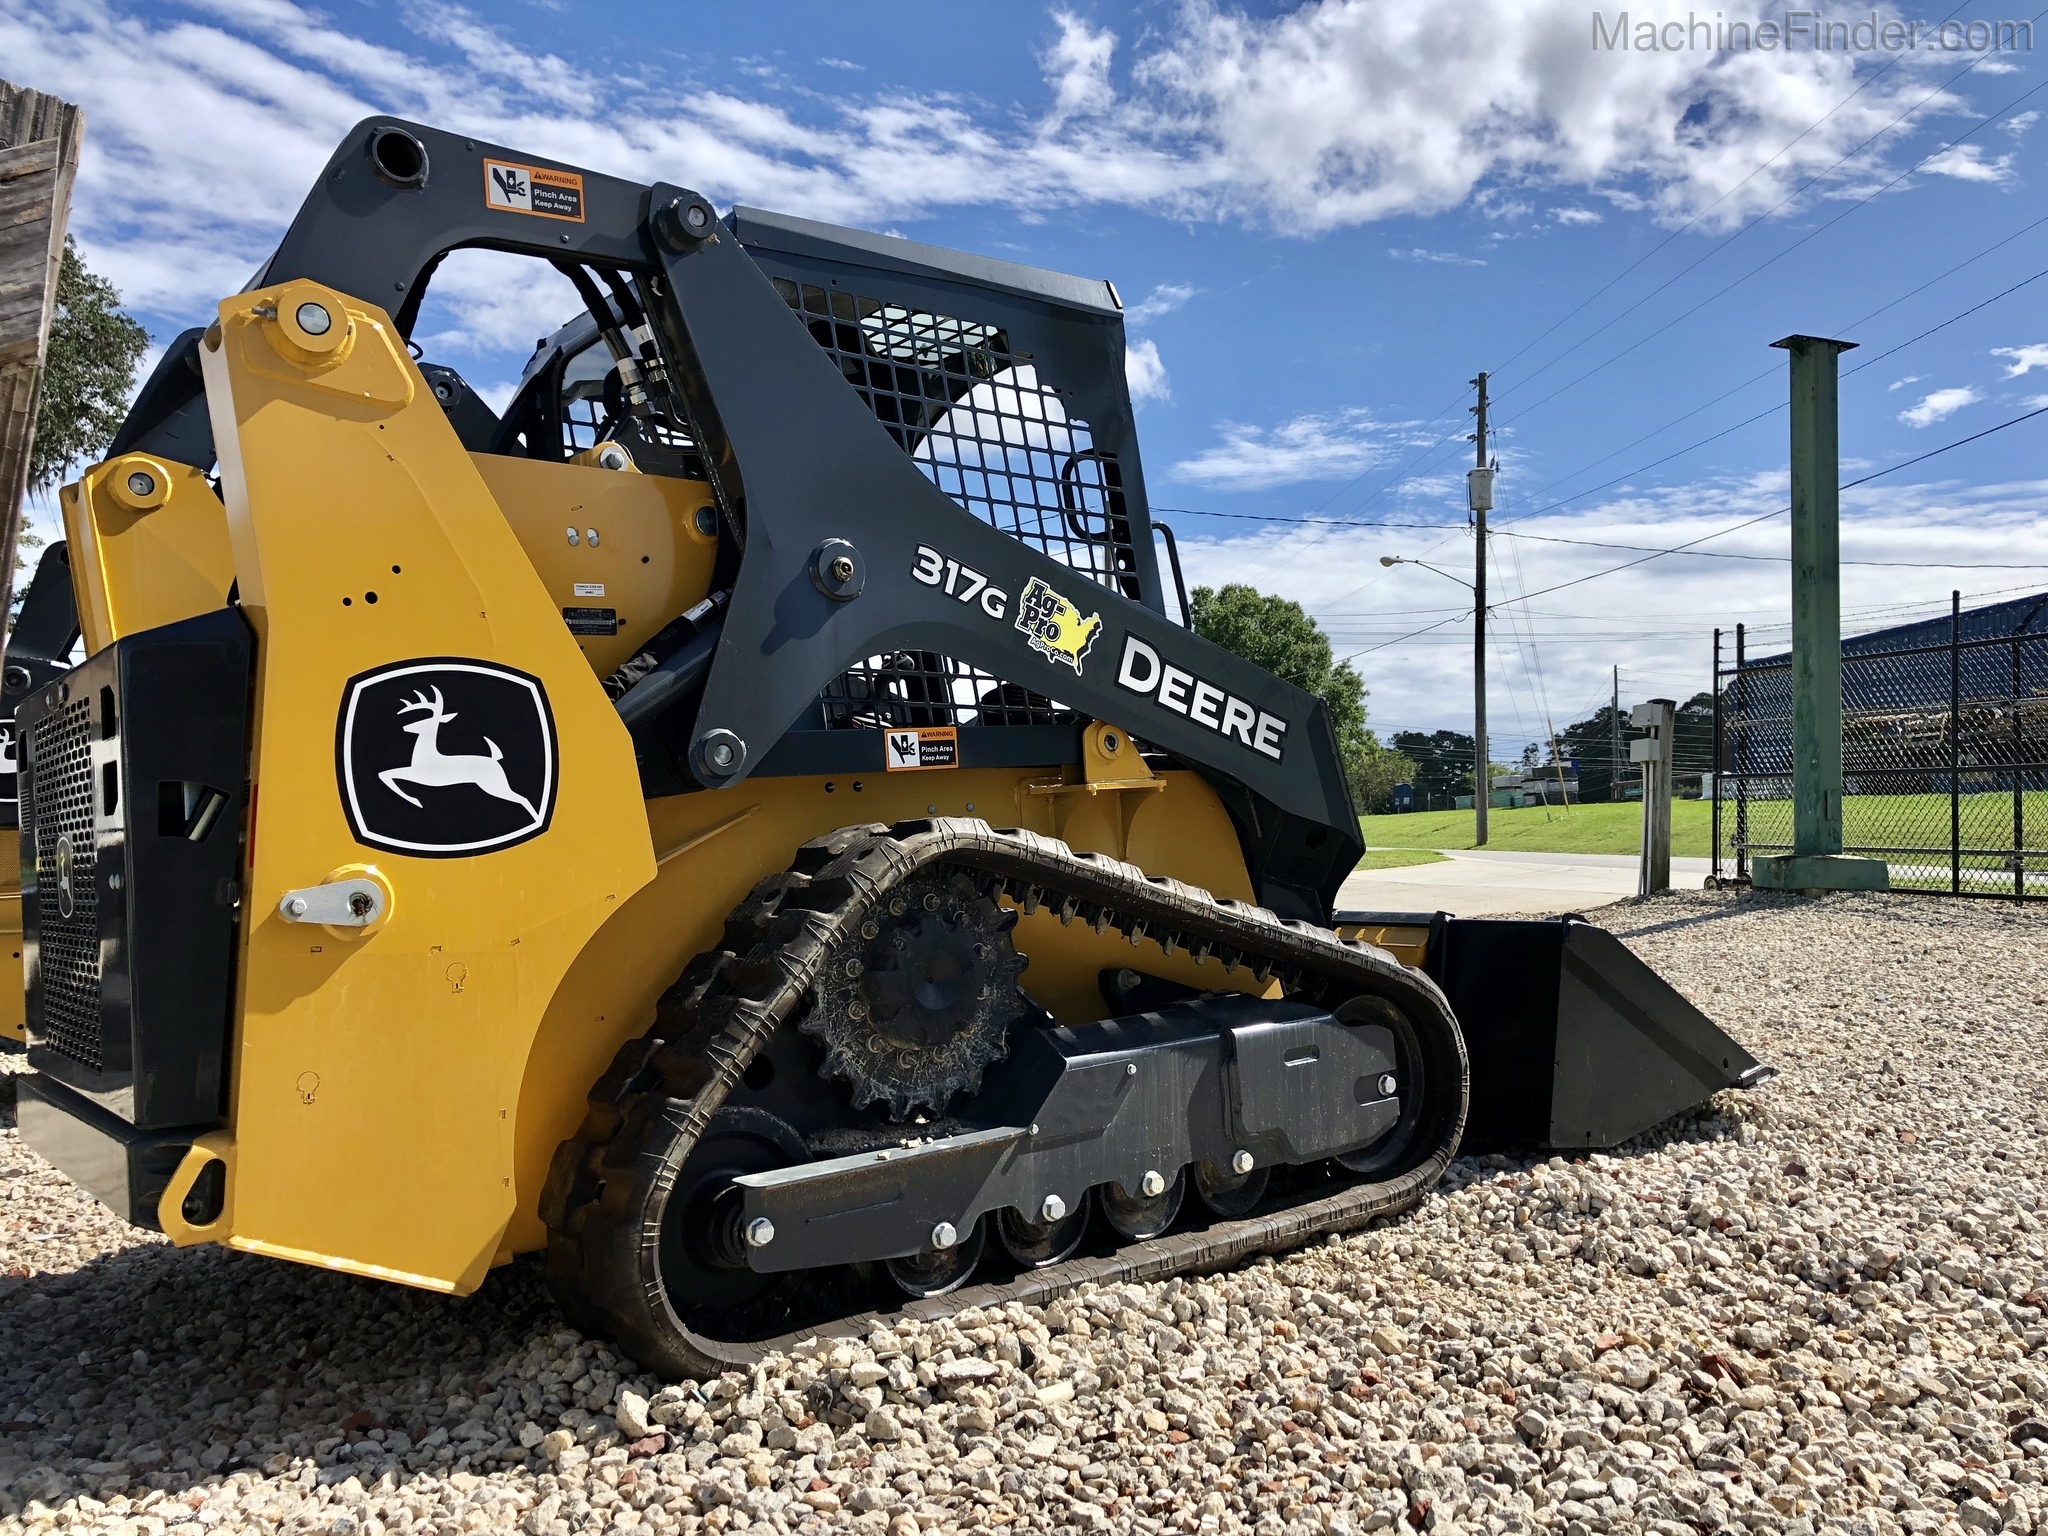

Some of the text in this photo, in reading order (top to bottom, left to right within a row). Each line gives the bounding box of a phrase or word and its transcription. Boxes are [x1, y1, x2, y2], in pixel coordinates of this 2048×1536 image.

[541, 174, 578, 185] WARNING
[534, 188, 578, 203] Pinch Area
[534, 199, 572, 212] Keep Away
[911, 546, 1008, 620] 317G
[1024, 582, 1066, 618] Ag-
[1018, 604, 1061, 641] Pro
[1031, 637, 1074, 663] AgProCo.com
[1117, 635, 1287, 760] DEERE
